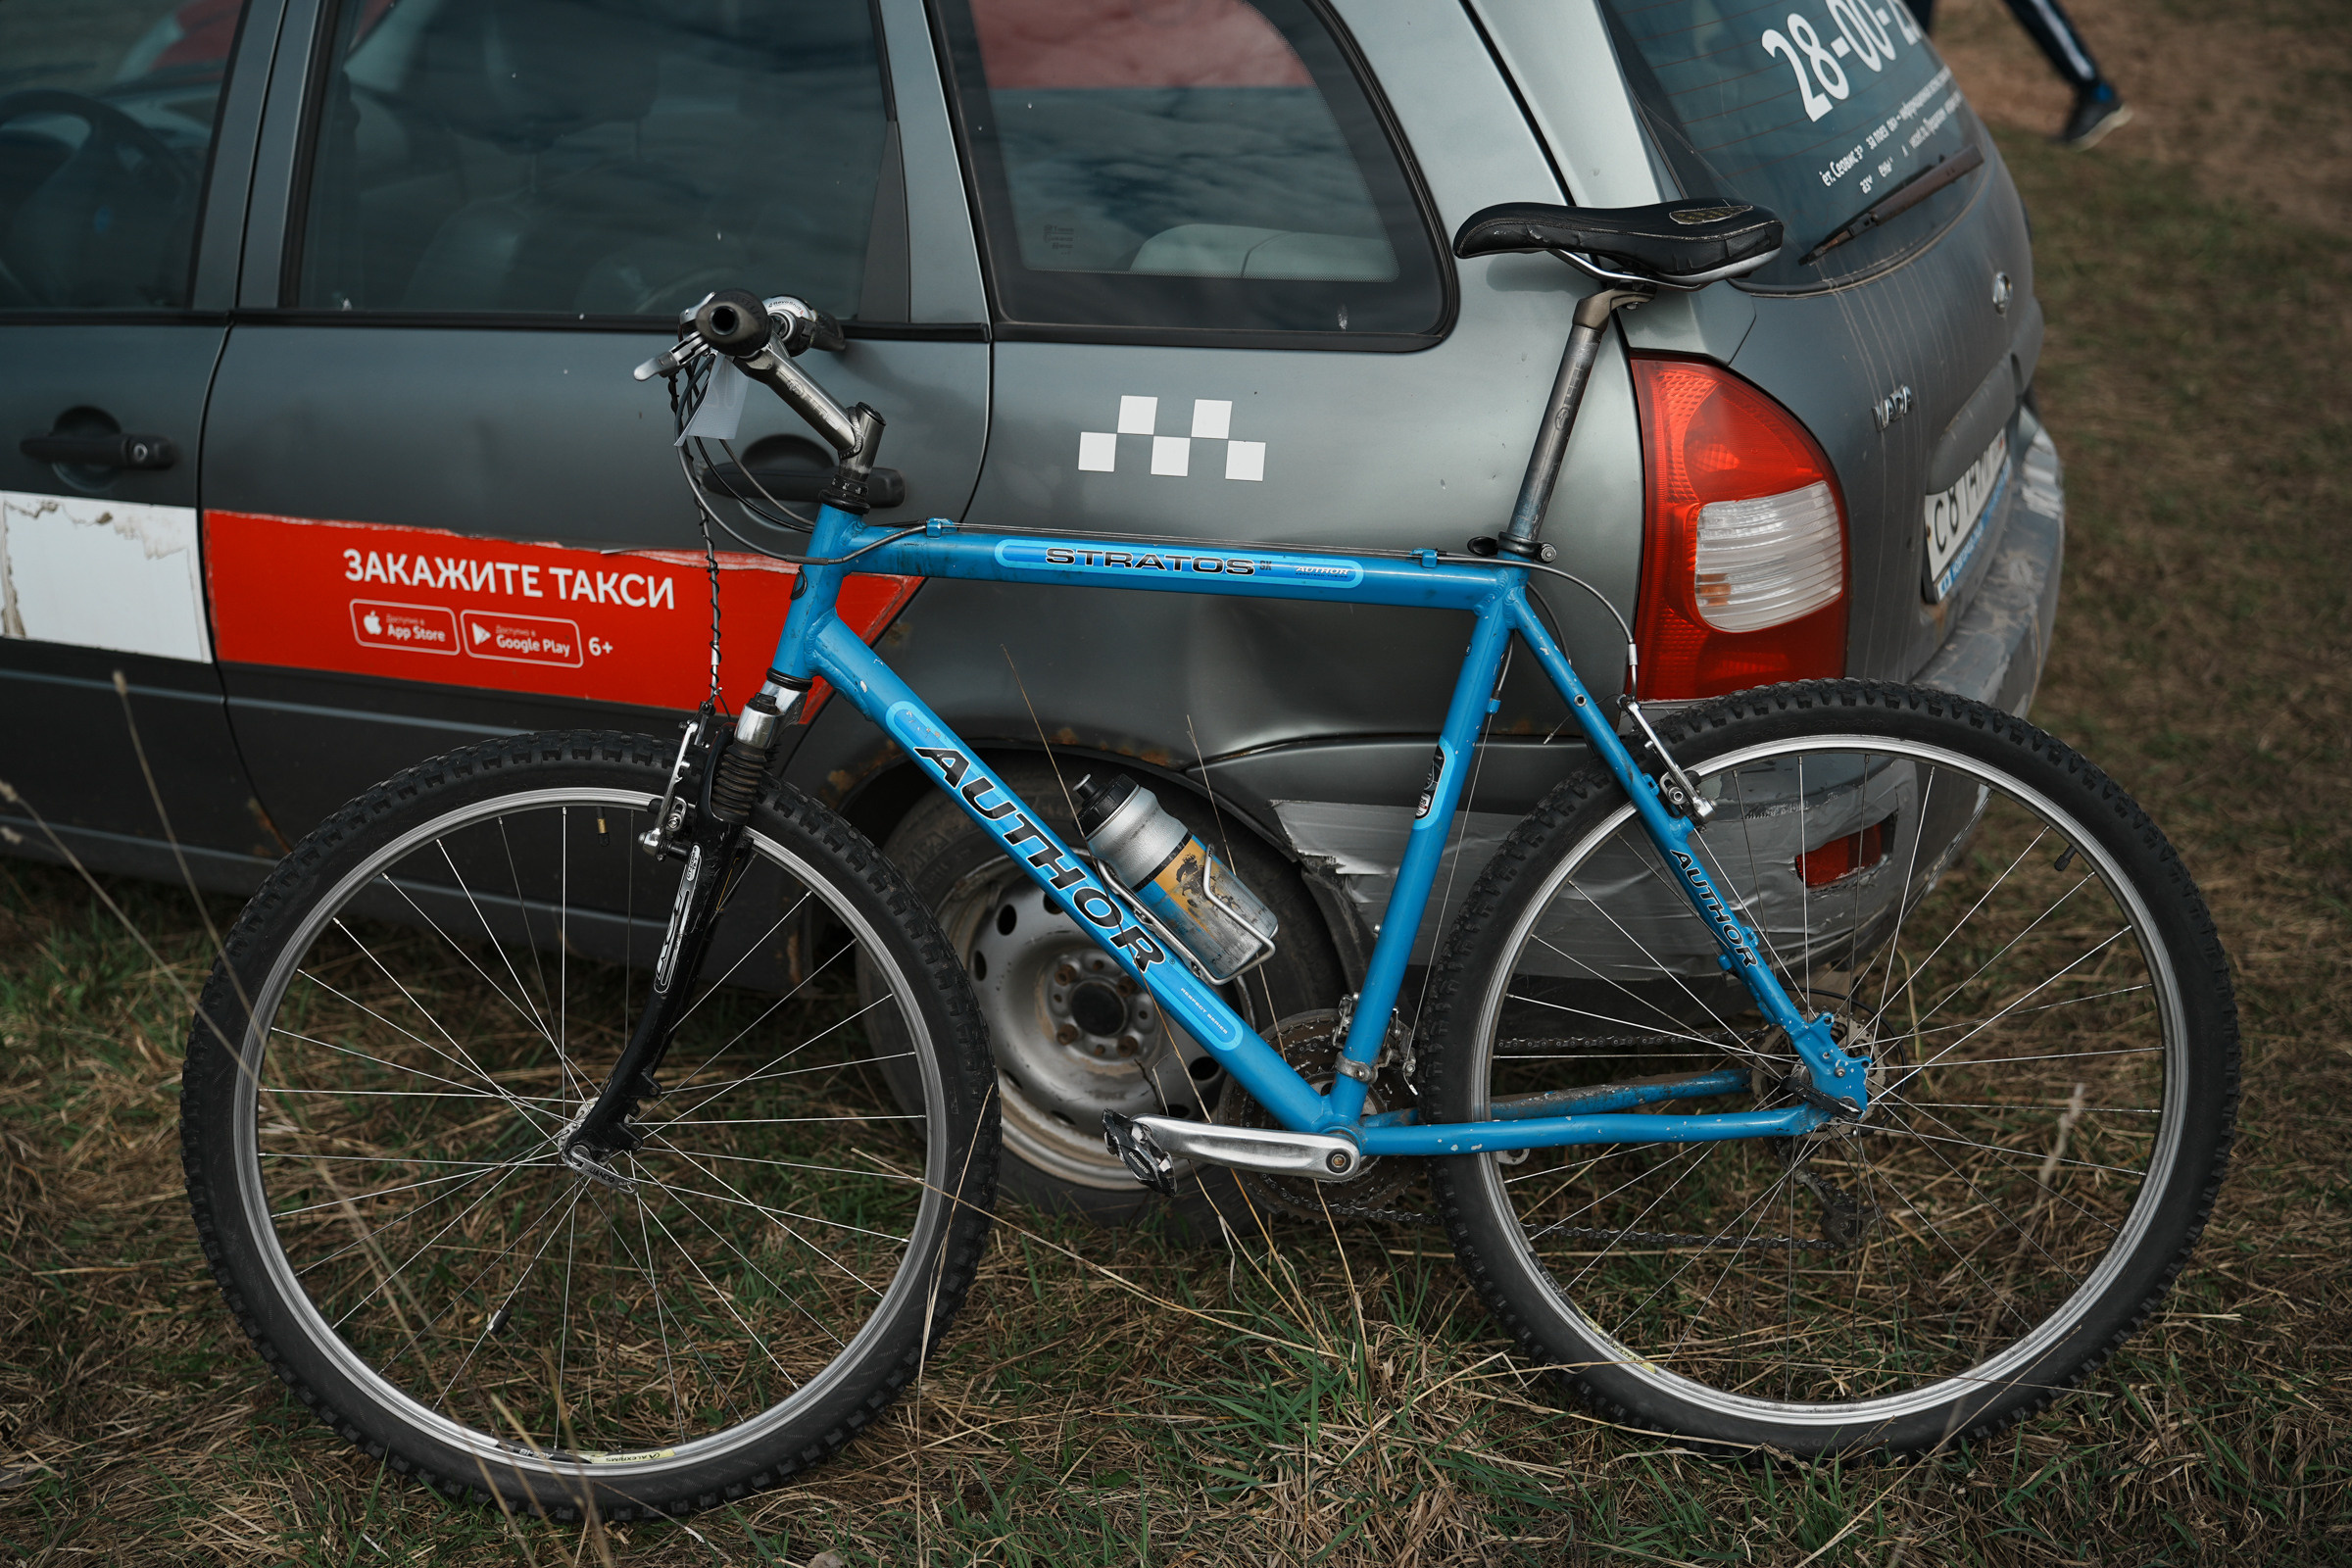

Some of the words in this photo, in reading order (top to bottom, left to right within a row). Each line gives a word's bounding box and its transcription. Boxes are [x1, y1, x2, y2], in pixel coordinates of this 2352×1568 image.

[1045, 547, 1255, 576] STRATOS
[1295, 564, 1350, 576] AUTHOR
[343, 548, 543, 597] ЗАКАЖИТЕ
[549, 566, 675, 610] ТАКСИ
[387, 624, 411, 641] App
[413, 625, 446, 642] Store
[496, 636, 540, 654] Google
[542, 638, 570, 657] Play
[588, 637, 613, 656] 6+
[913, 747, 1166, 972] AUTHOR
[1669, 849, 1758, 967] AUTHOR
[1180, 987, 1207, 1014] RESPECT
